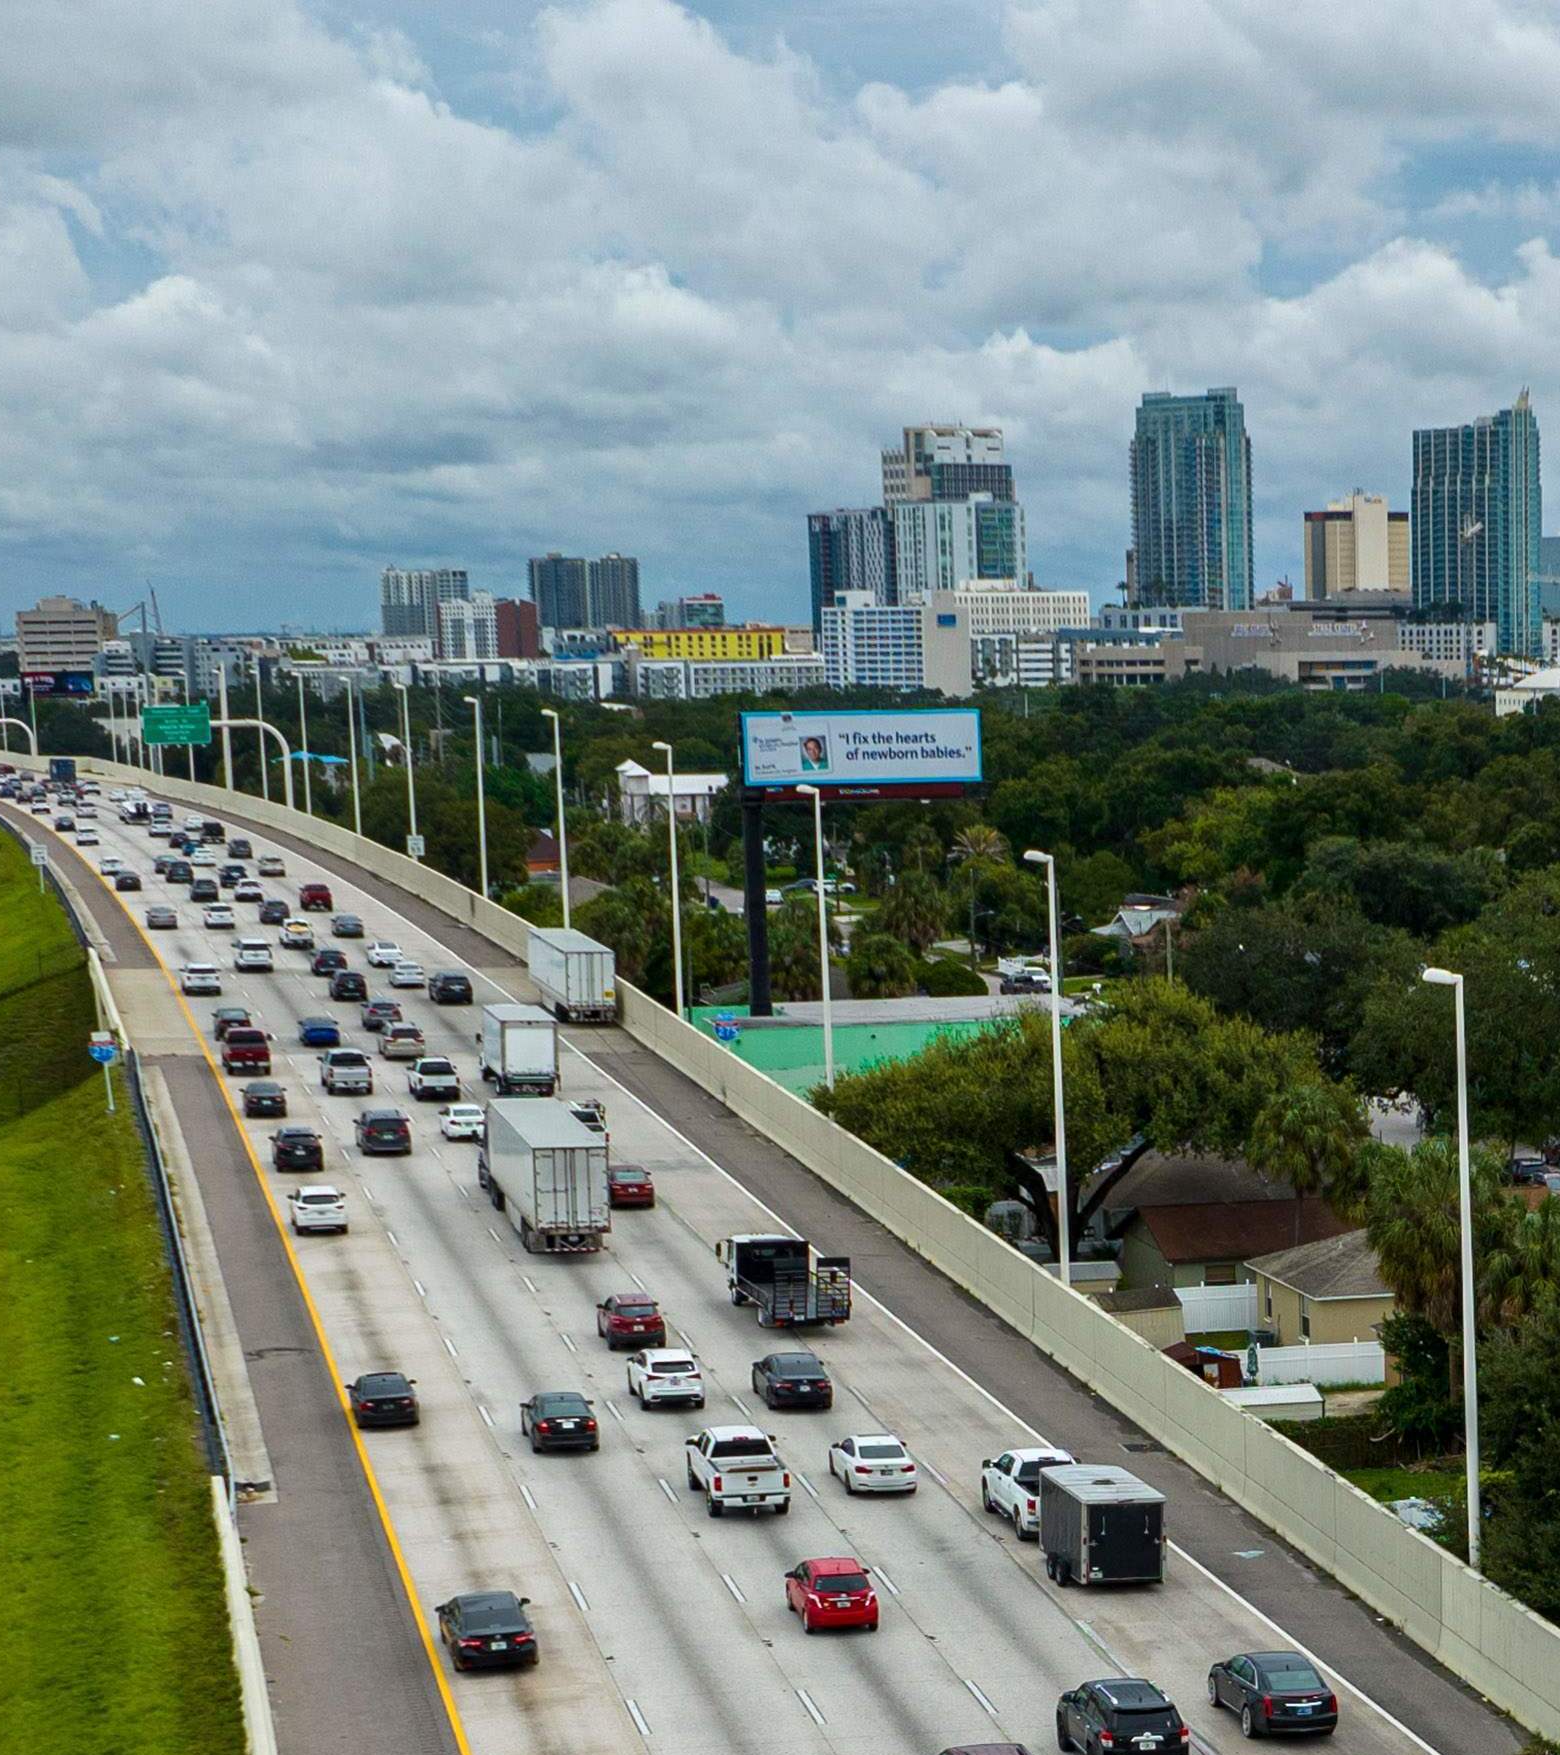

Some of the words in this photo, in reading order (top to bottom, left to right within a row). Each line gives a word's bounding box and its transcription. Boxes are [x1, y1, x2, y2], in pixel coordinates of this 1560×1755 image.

[853, 731, 870, 745] fix
[872, 731, 894, 745] the
[896, 731, 937, 745] hearts
[846, 747, 860, 761] of
[862, 746, 919, 761] newborn
